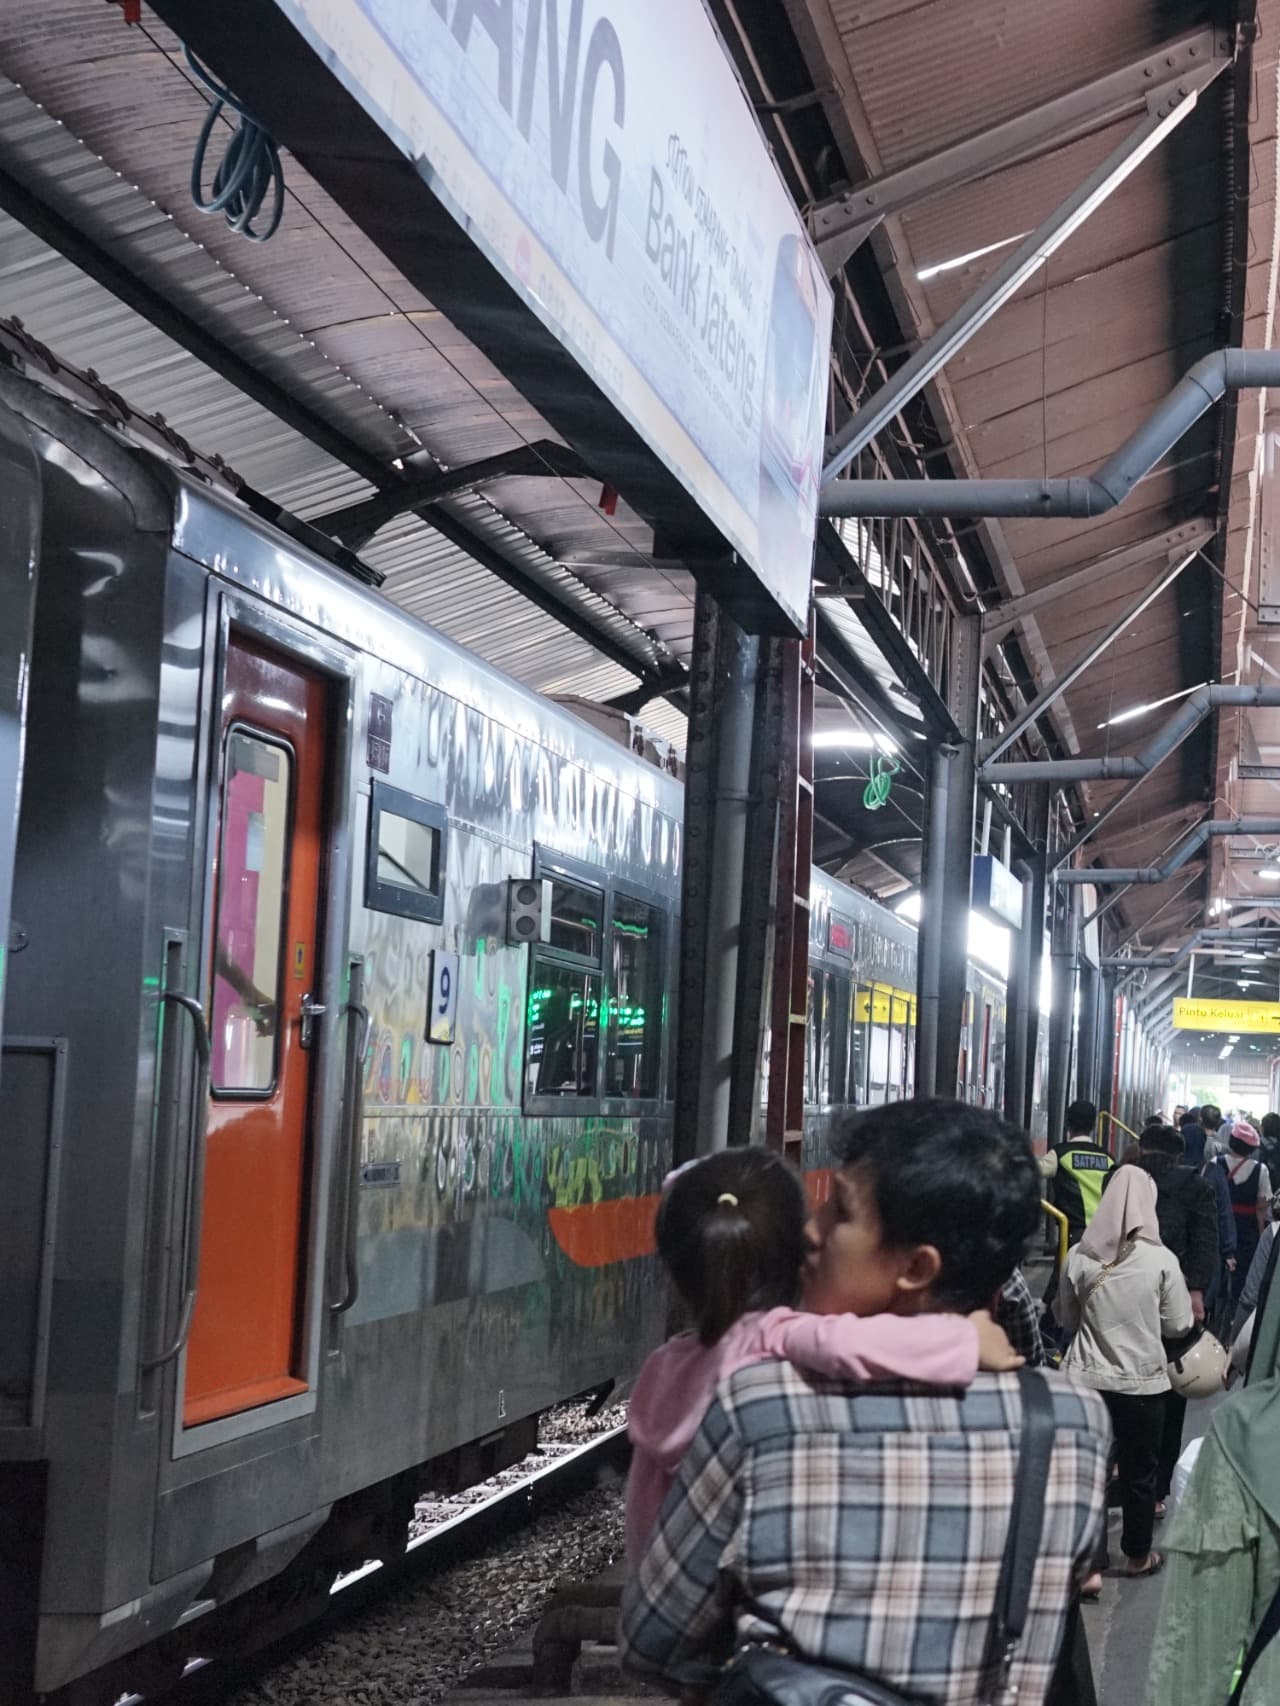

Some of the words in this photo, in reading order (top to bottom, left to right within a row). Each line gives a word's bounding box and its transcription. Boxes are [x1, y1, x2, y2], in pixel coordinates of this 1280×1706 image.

[645, 165, 700, 328] Bank
[700, 264, 756, 428] Jateng
[439, 965, 450, 1015] 9
[1179, 1007, 1207, 1017] Pintu
[1210, 1008, 1244, 1019] Keluar
[1074, 1154, 1109, 1170] SATPAM
